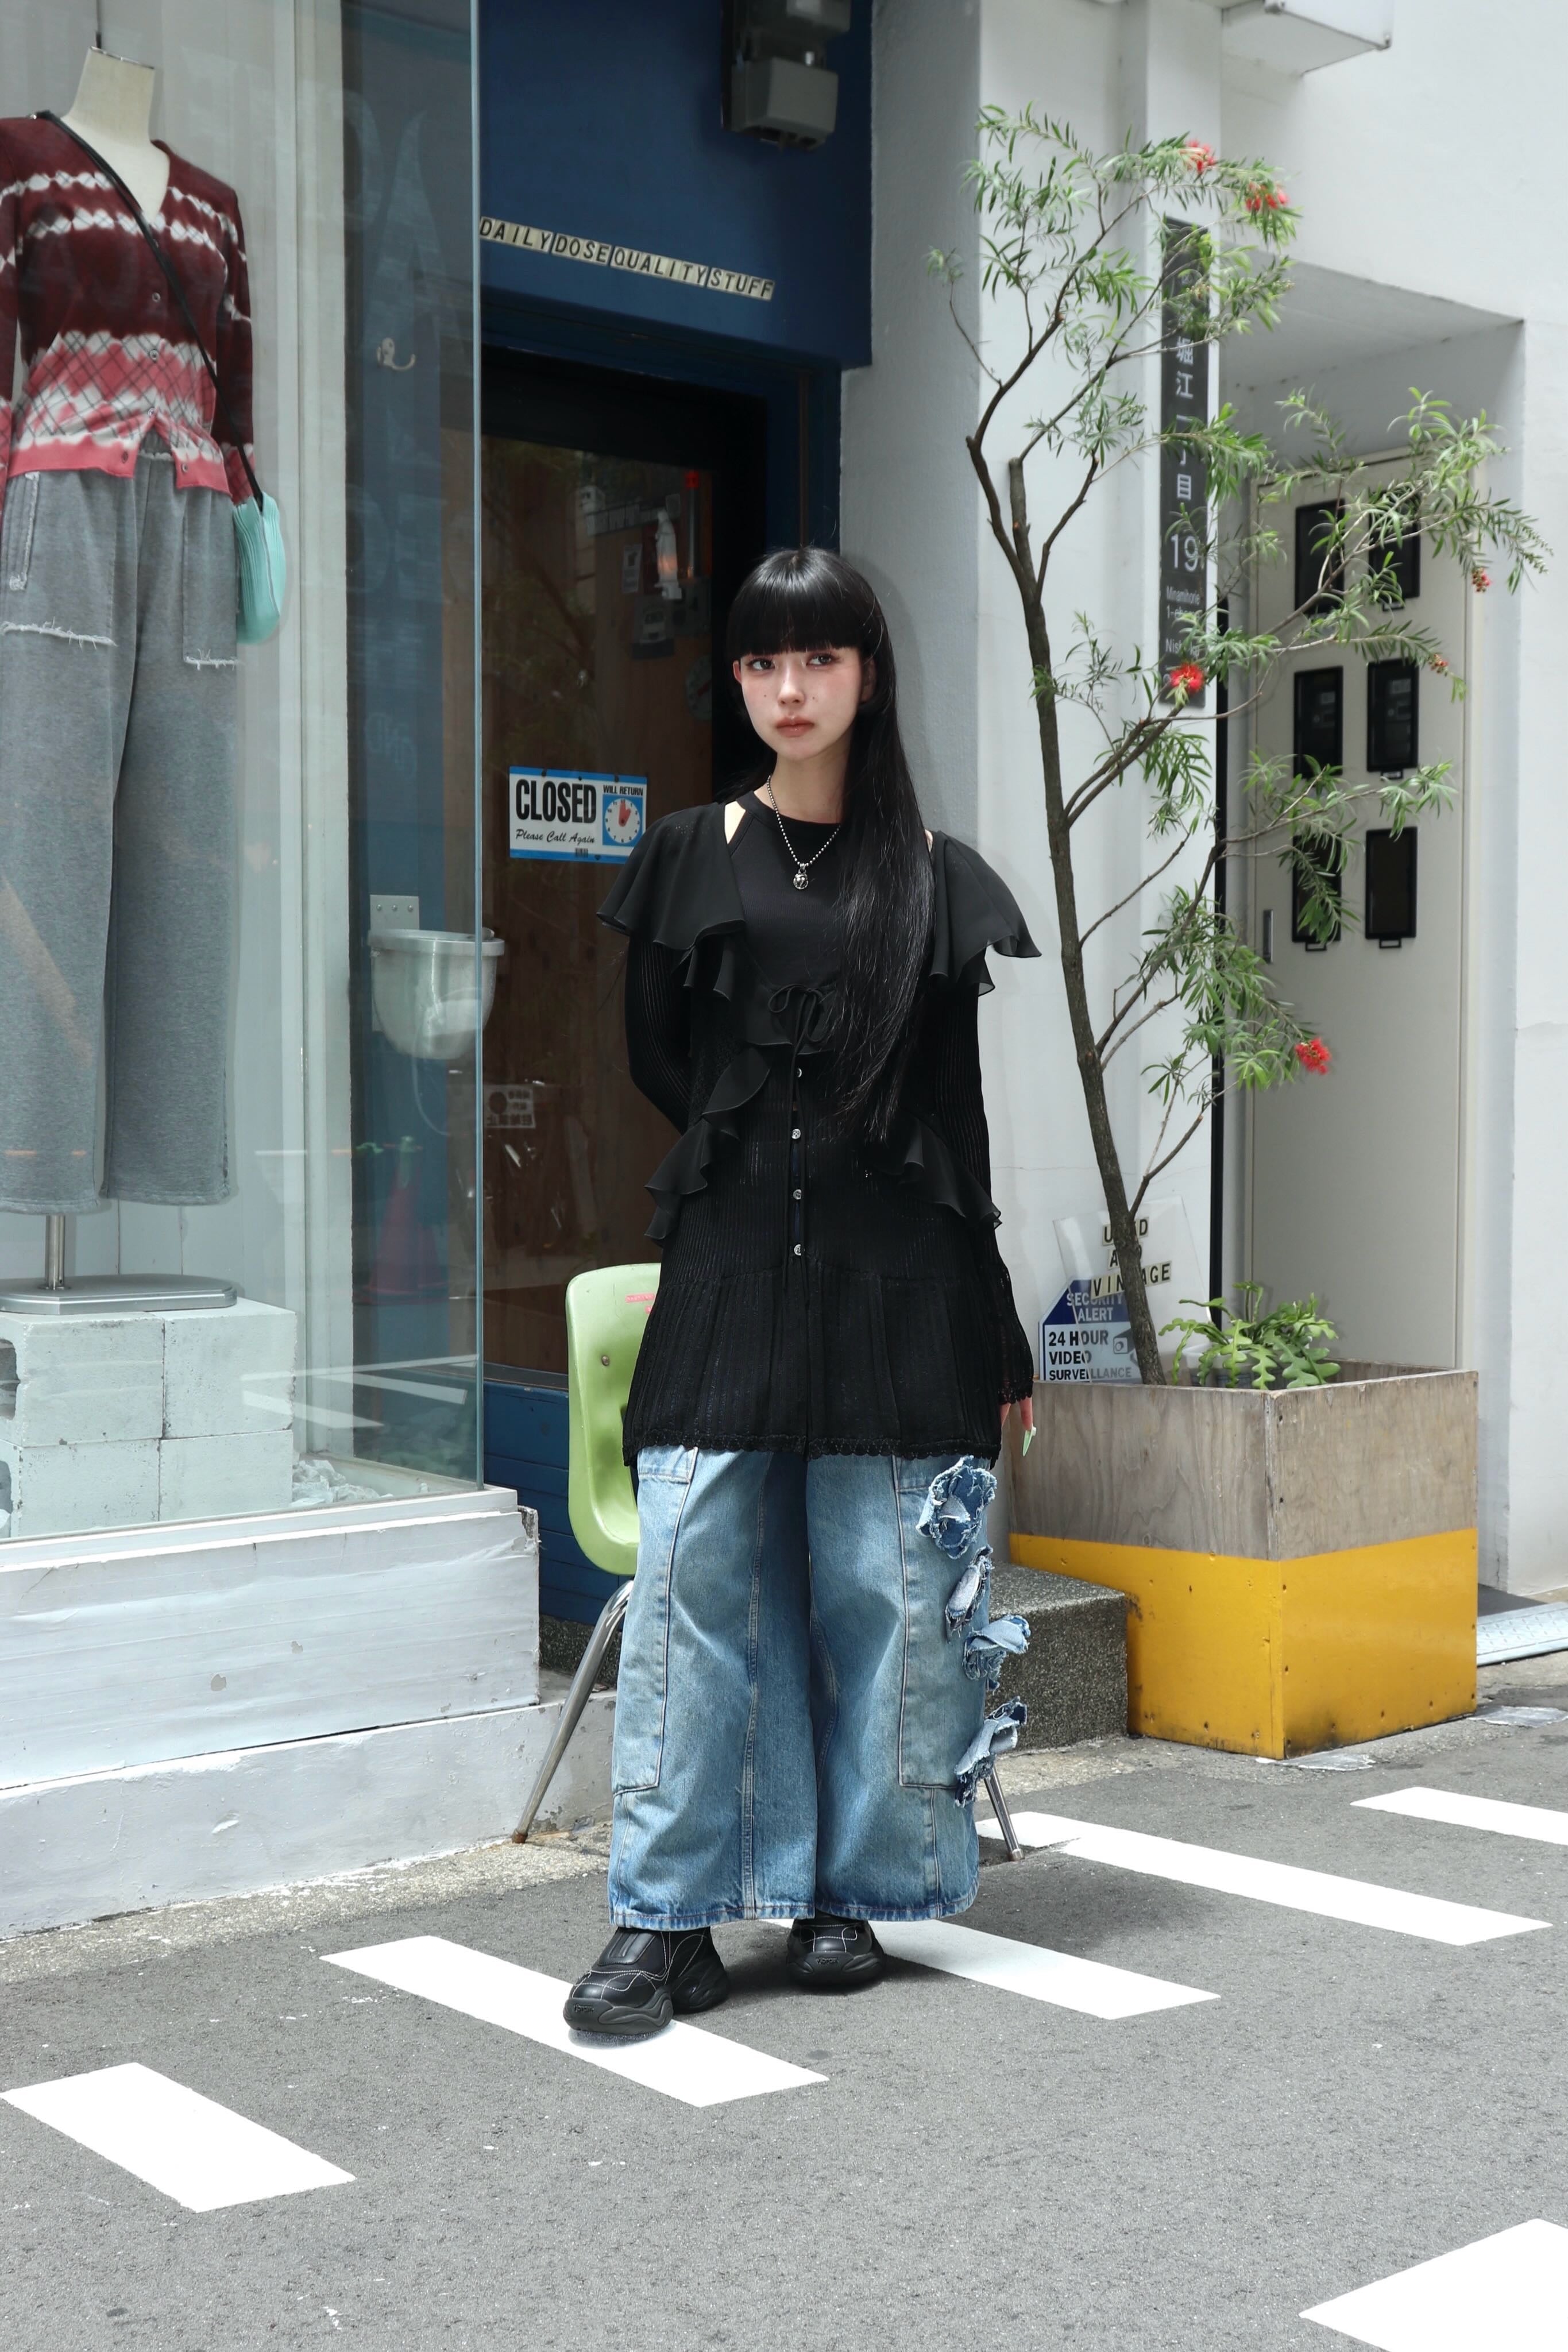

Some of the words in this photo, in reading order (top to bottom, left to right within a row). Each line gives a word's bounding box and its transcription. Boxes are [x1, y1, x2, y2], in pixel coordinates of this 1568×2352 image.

[480, 218, 550, 249] DAILY
[555, 235, 609, 262] DOSE
[614, 248, 706, 284] QUALITY
[710, 269, 774, 297] STUFF
[1171, 534, 1198, 571] 19
[603, 785, 617, 794] WILL
[620, 786, 643, 795] RETURN
[516, 779, 597, 824] CLOSED
[516, 829, 543, 840] Please
[546, 831, 567, 843] Call
[569, 832, 595, 845] Again
[1104, 1219, 1148, 1243] UD
[1093, 1263, 1171, 1296] VINAGE
[1078, 1307, 1113, 1322] ALERT
[1048, 1331, 1065, 1346] 24
[1069, 1330, 1109, 1346] HOUR
[1049, 1350, 1092, 1365] VIDEO
[1049, 1367, 1132, 1381] SURVEILLANCE
